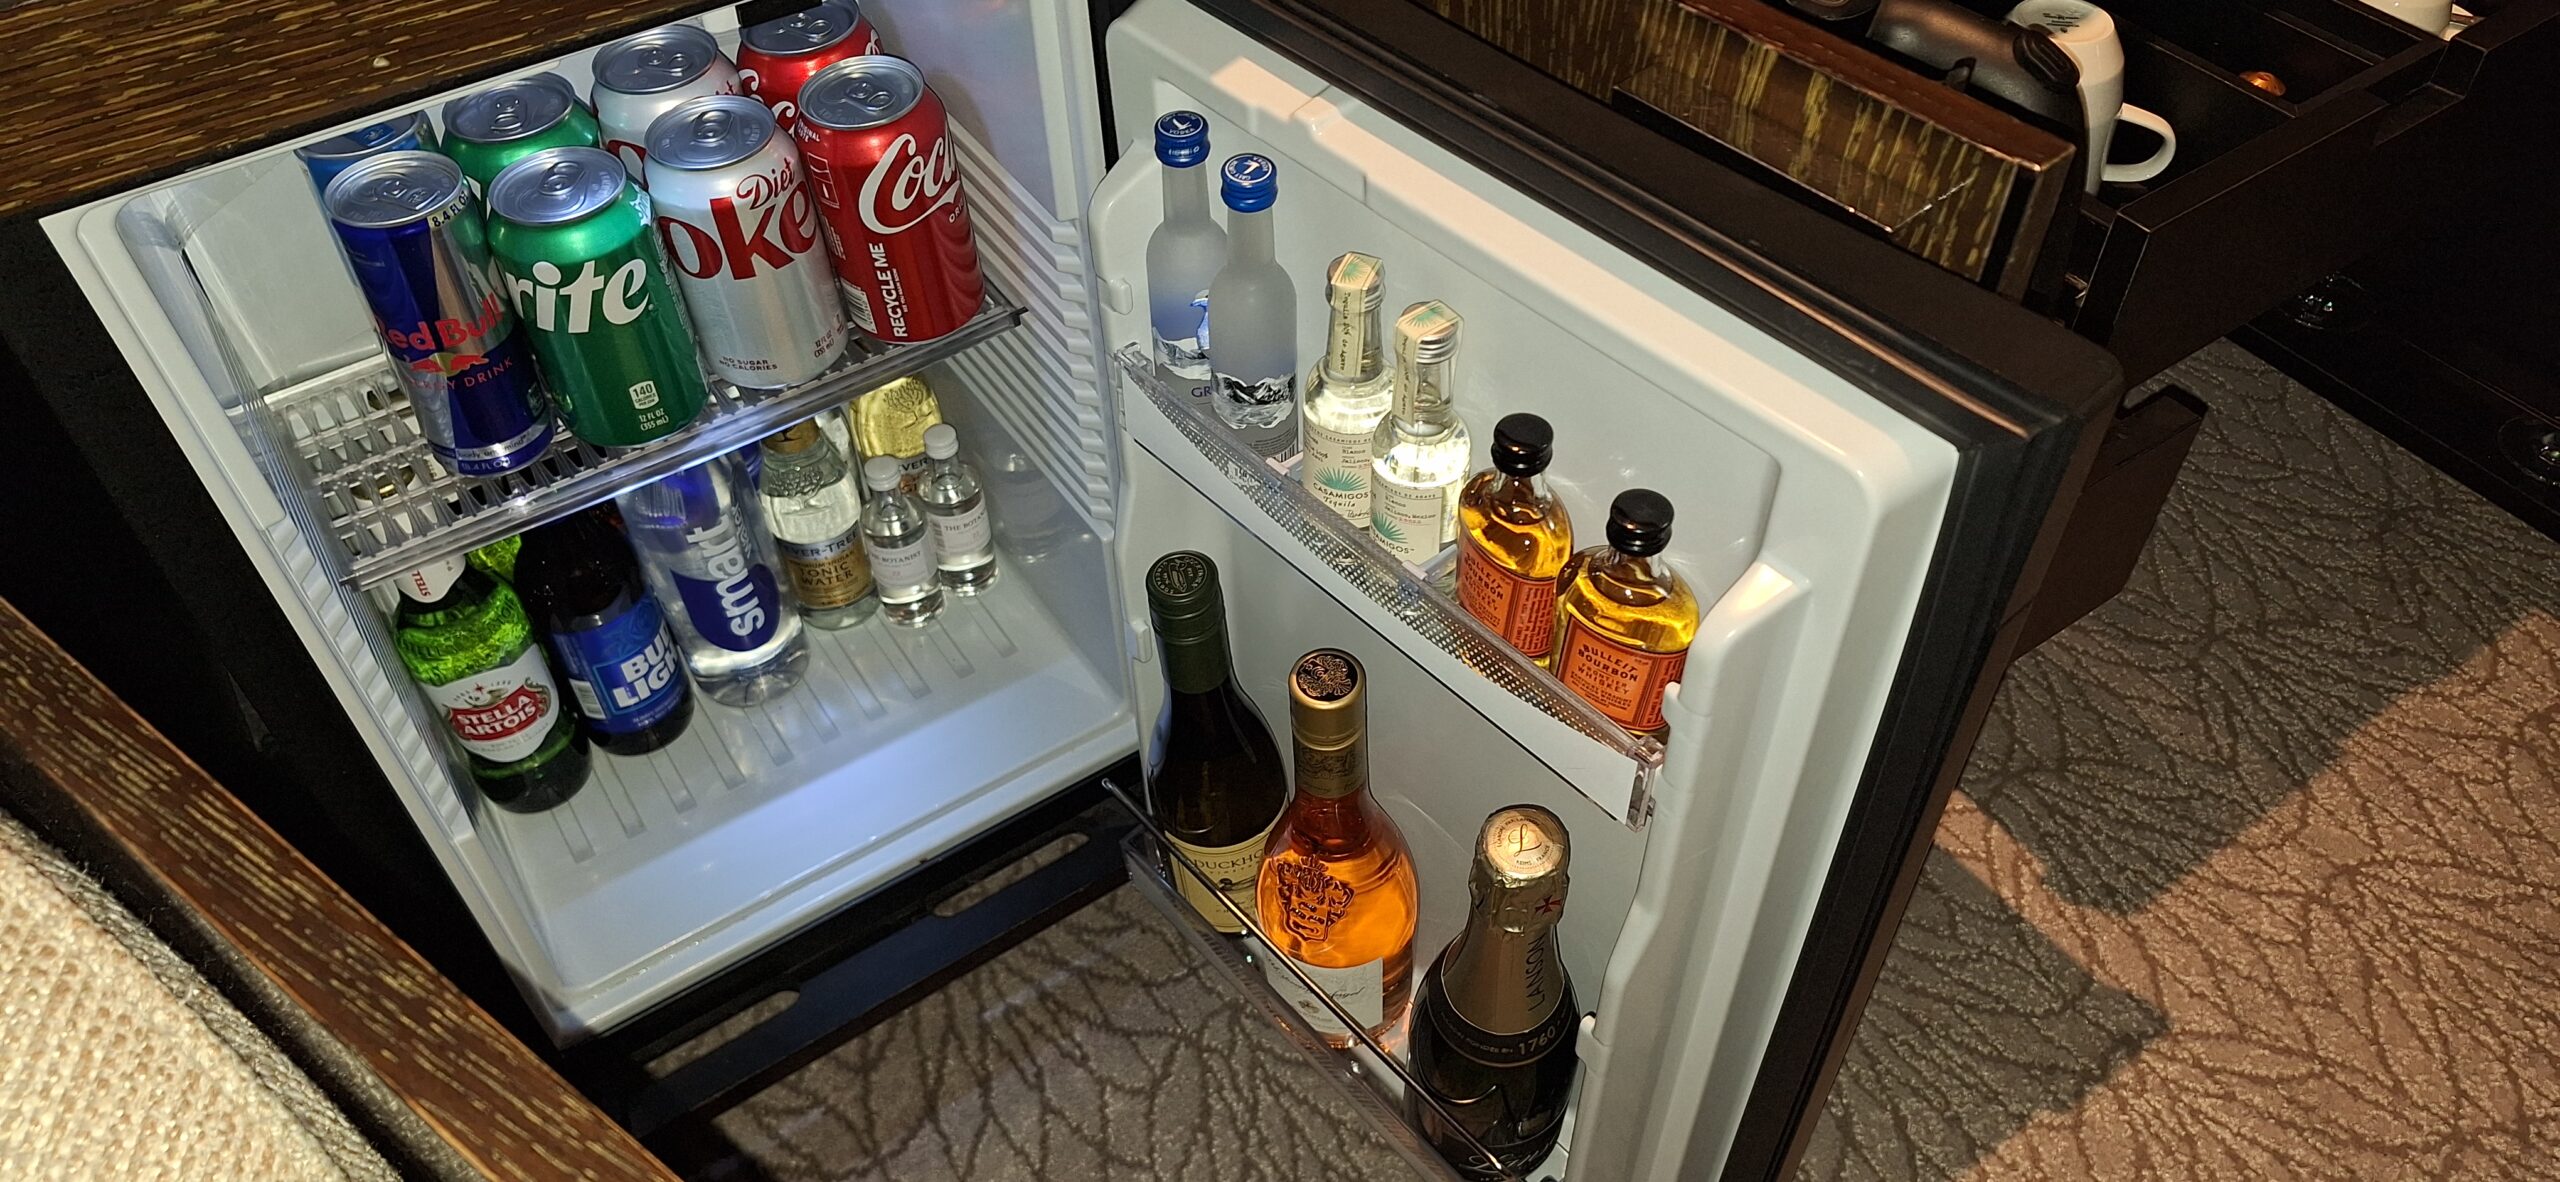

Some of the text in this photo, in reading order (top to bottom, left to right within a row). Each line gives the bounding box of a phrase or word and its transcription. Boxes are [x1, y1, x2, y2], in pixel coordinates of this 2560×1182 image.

[736, 158, 794, 210] Diet
[432, 210, 450, 228] 8.4
[450, 203, 460, 215] FL
[658, 180, 817, 280] oke
[505, 258, 650, 334] rite
[869, 242, 908, 338] RECYCLE ME
[435, 291, 504, 347] Bull
[815, 339, 821, 348] 12
[464, 357, 513, 388] DRINK
[723, 356, 734, 364] NO
[733, 363, 778, 372] CALORIES
[632, 383, 653, 398] 140
[639, 408, 665, 422] 12 FL OZ
[640, 415, 669, 431] (355 mL)
[1313, 482, 1369, 500] CASAMIGOS
[1323, 495, 1356, 507] Tequila
[686, 514, 765, 637] smart
[800, 570, 853, 586] WATER
[1578, 648, 1638, 682] BOURBON
[1582, 644, 1638, 673] BULLEIT
[1577, 665, 1630, 695] WHISKEY
[1581, 662, 1627, 688] FRONTIER
[457, 695, 533, 726] STELLA
[464, 704, 536, 736] ARTOIS
[1507, 823, 1543, 858] L
[1525, 932, 1546, 1012] LANSON
[1518, 1026, 1556, 1056] 1760
